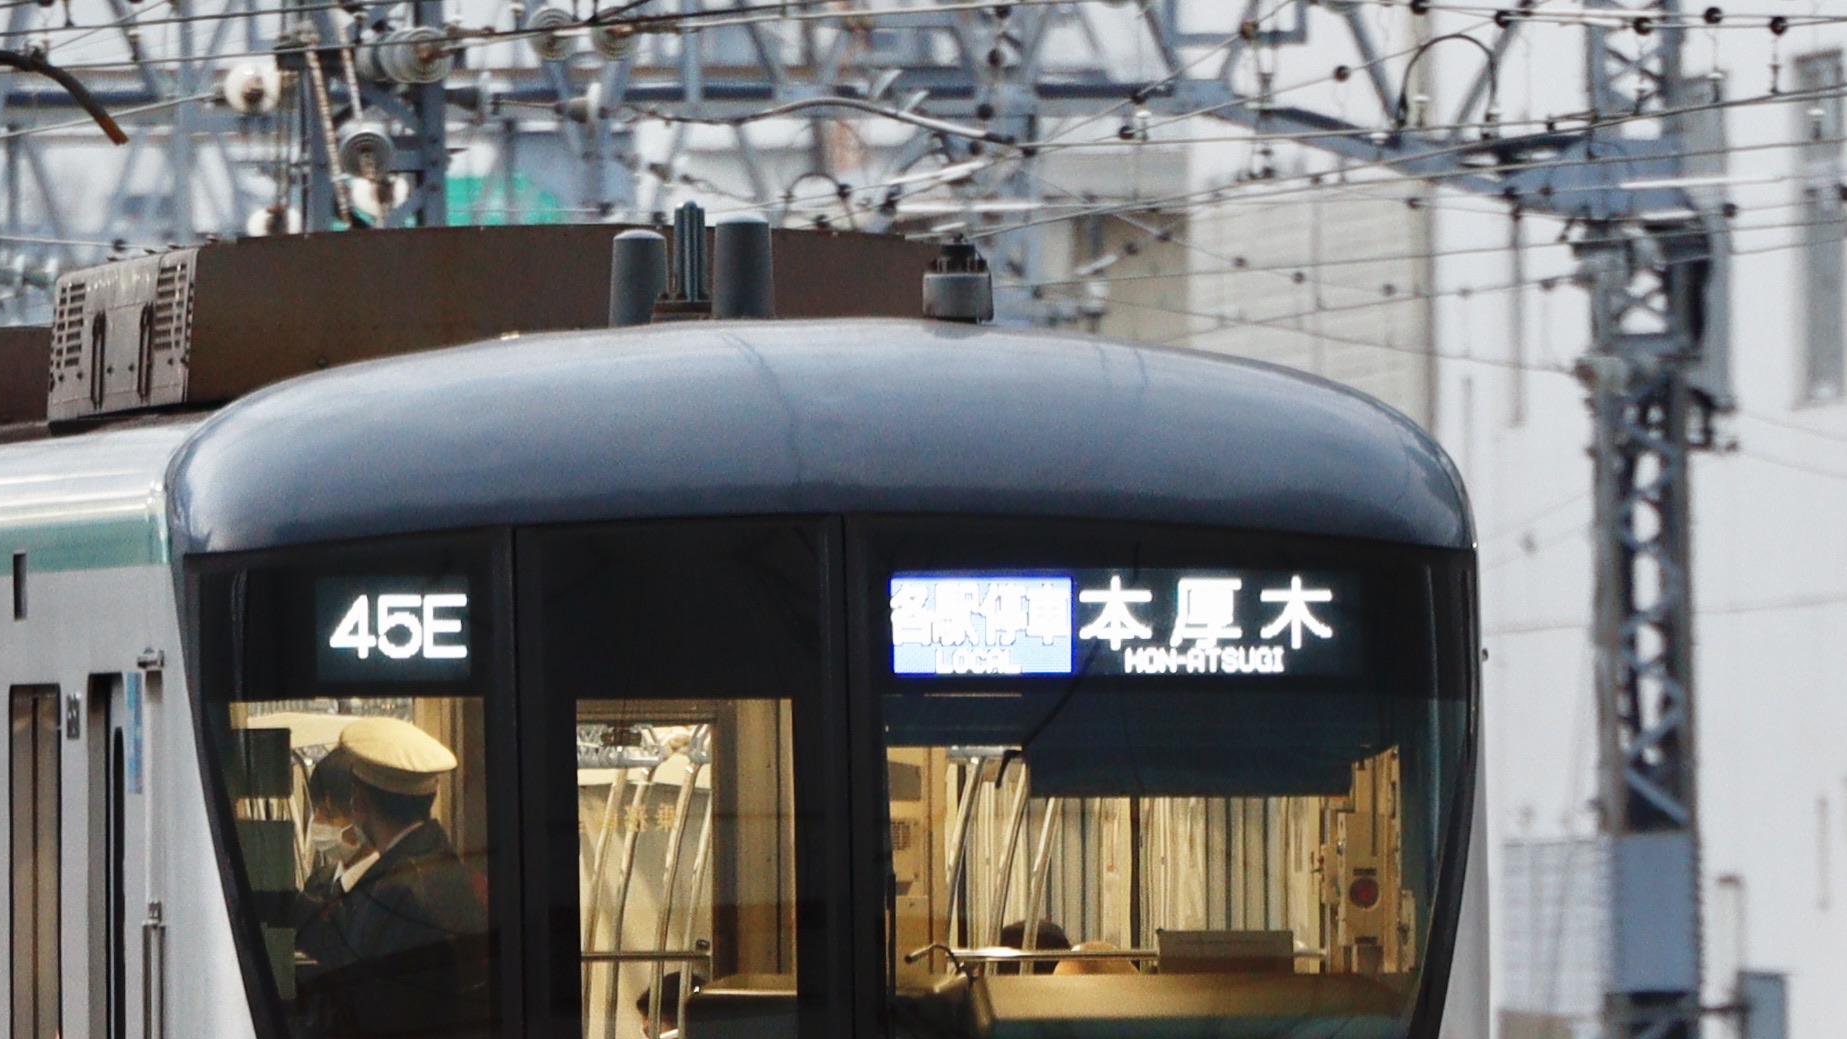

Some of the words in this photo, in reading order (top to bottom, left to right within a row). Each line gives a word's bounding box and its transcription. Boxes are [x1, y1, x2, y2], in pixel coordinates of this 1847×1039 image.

[330, 594, 468, 659] 45E
[1079, 574, 1333, 650] 本厚木
[936, 648, 1021, 673] LOCAL
[1125, 646, 1284, 674] HON-ATSUGI
